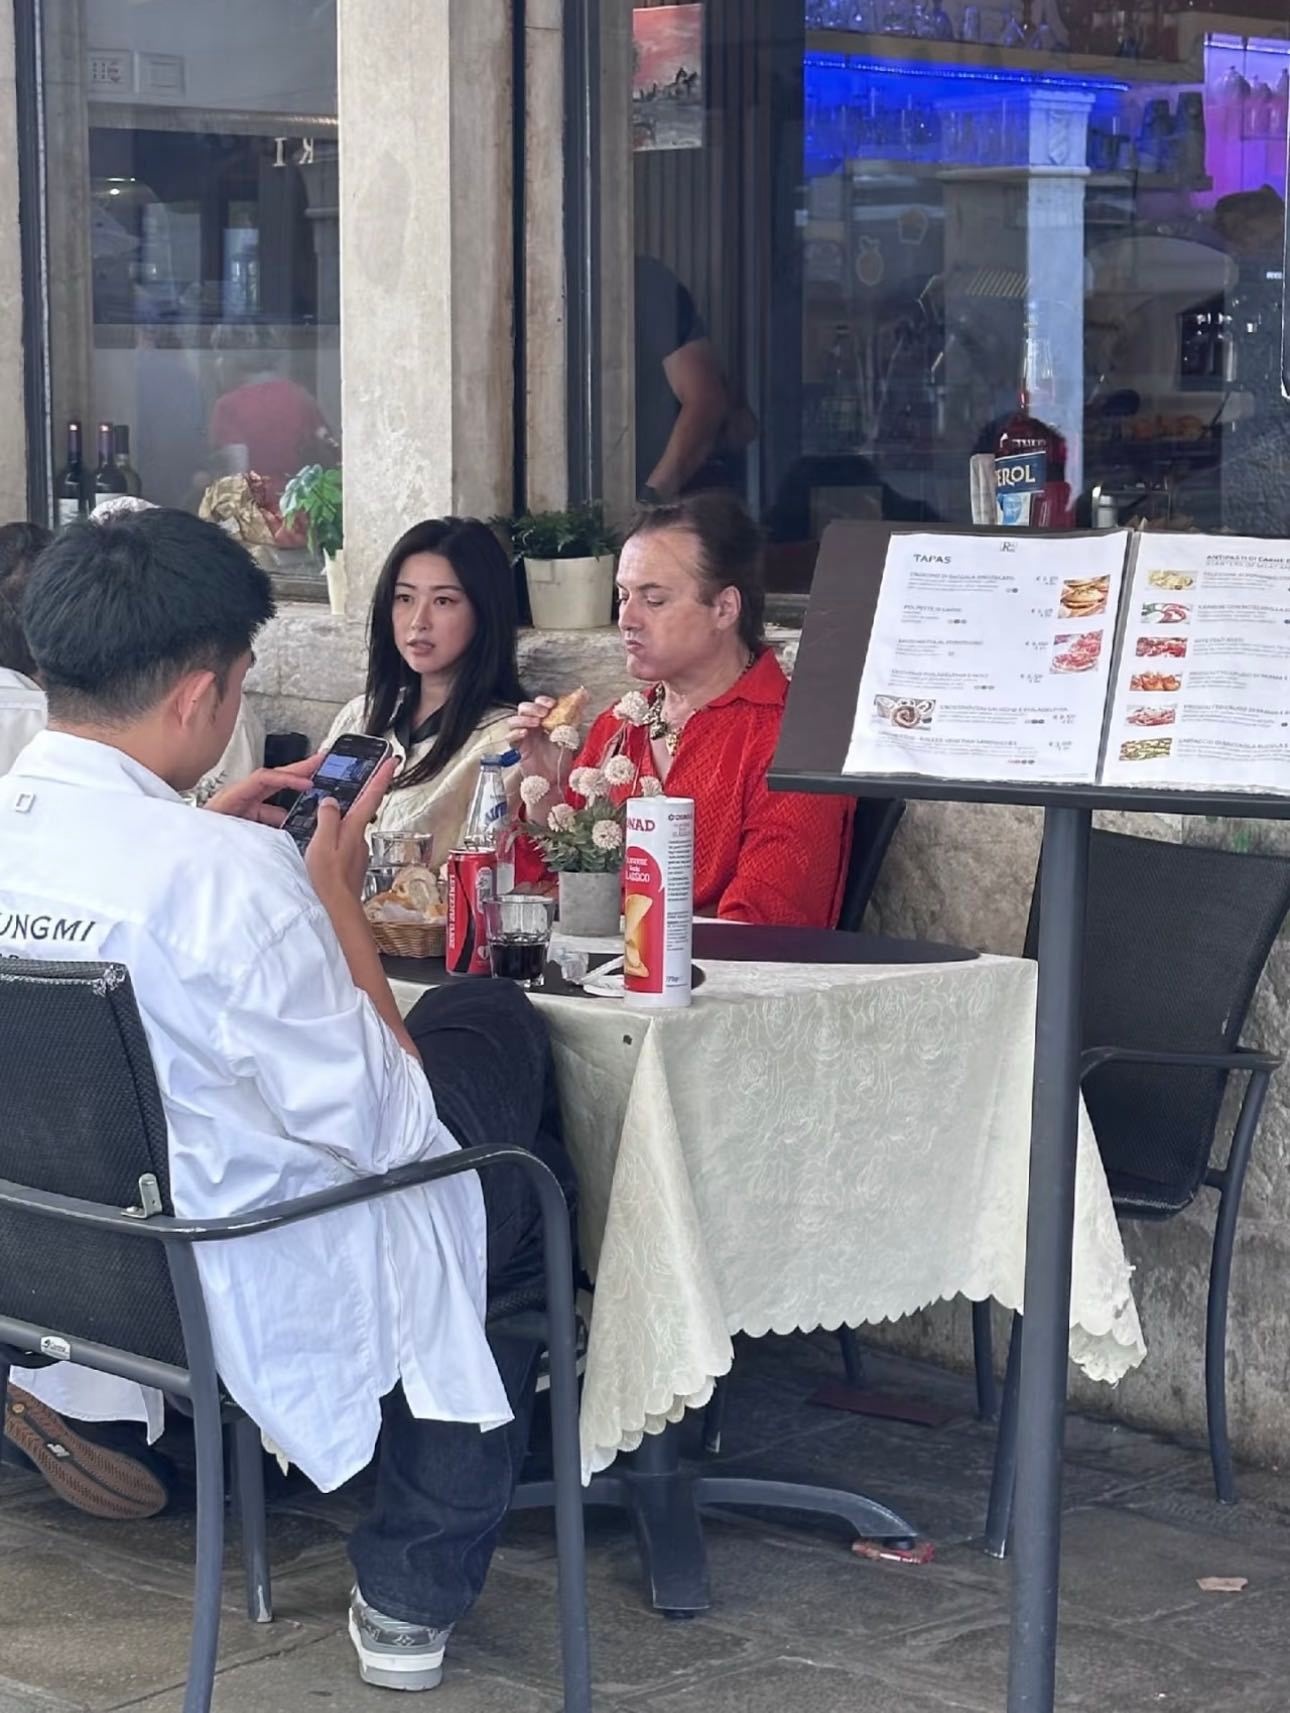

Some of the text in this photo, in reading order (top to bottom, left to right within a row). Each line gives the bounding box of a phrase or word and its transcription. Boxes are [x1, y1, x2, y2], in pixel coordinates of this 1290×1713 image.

[994, 465, 1036, 487] EROL
[913, 555, 952, 565] TAPAS
[626, 817, 656, 832] NAD
[0, 913, 96, 941] UNGMI
